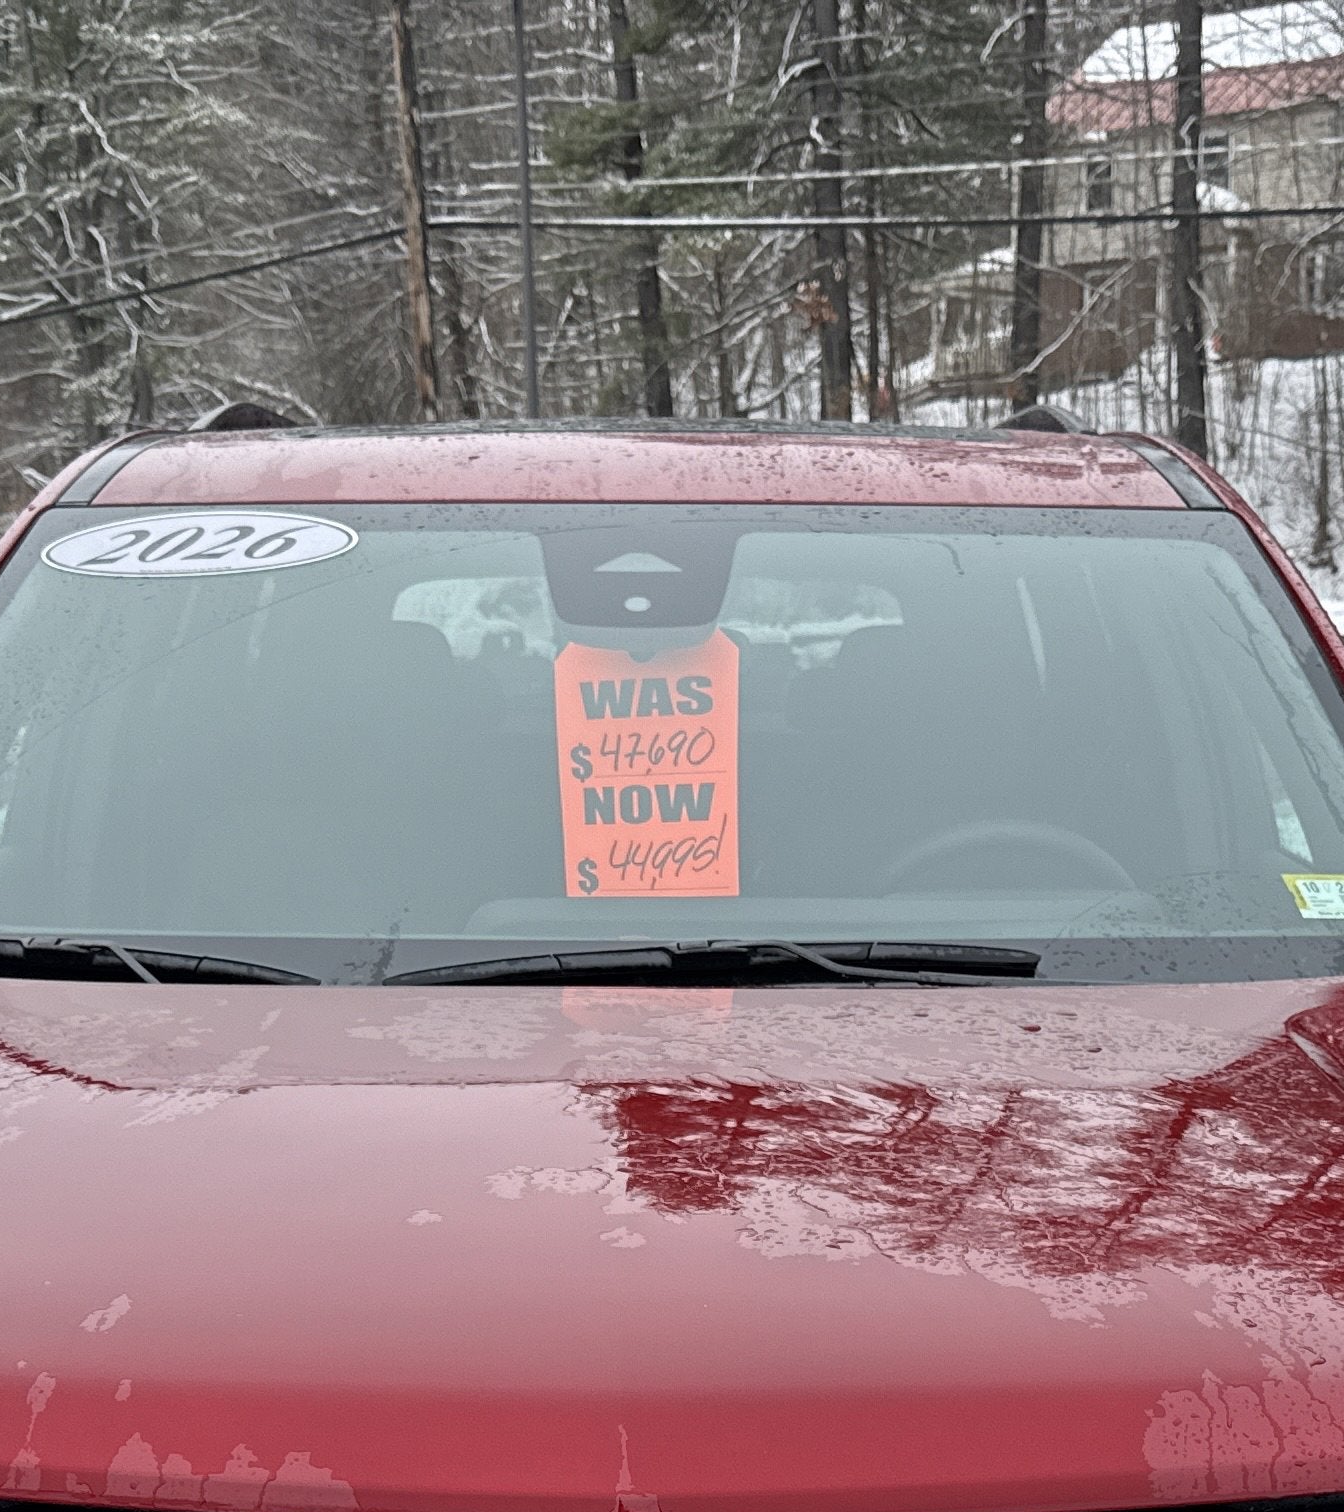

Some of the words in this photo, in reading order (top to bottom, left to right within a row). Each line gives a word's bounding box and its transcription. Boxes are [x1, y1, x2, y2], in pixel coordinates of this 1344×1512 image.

[77, 525, 321, 567] 2026
[580, 676, 714, 720] WAS
[570, 743, 594, 782] $
[599, 727, 716, 776] 47,690
[583, 782, 716, 825] NOW
[577, 857, 600, 895] $
[1302, 881, 1320, 894] 10
